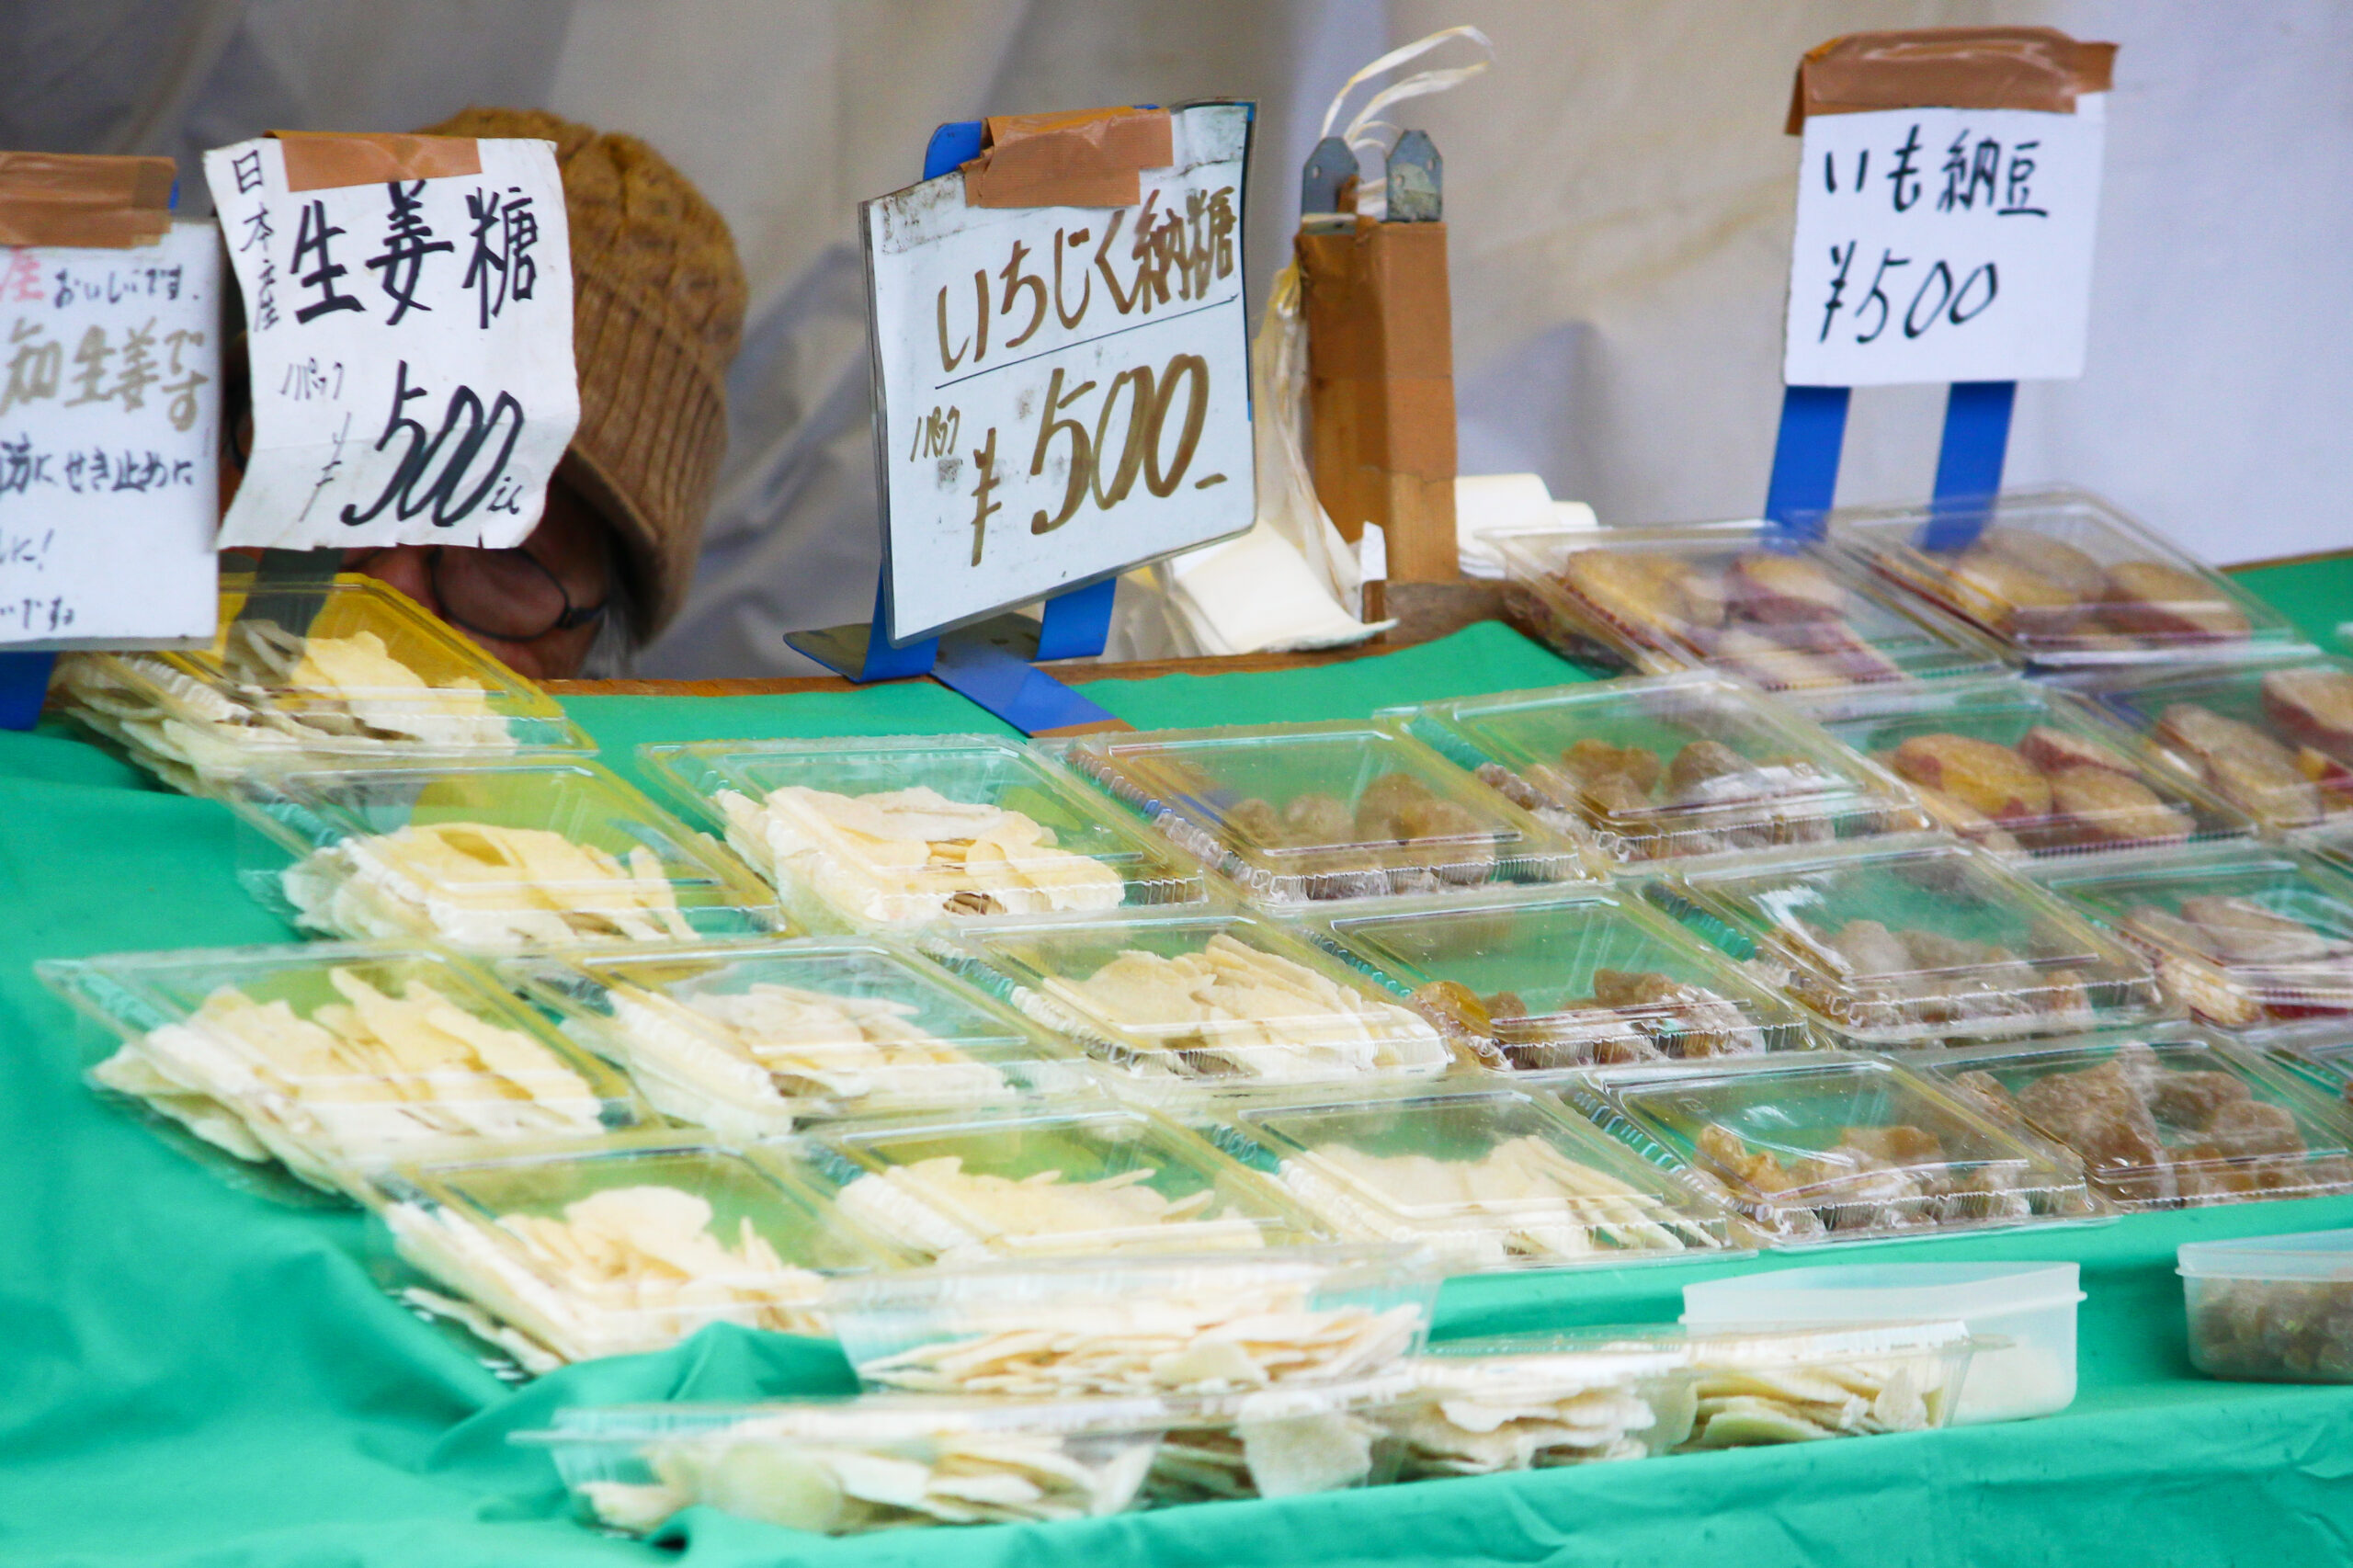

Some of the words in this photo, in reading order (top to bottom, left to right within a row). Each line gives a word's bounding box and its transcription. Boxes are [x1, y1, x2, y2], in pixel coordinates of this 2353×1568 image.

[1824, 124, 2050, 218] いも納豆
[290, 179, 539, 330] 生姜糖
[1819, 240, 2000, 345] ¥500
